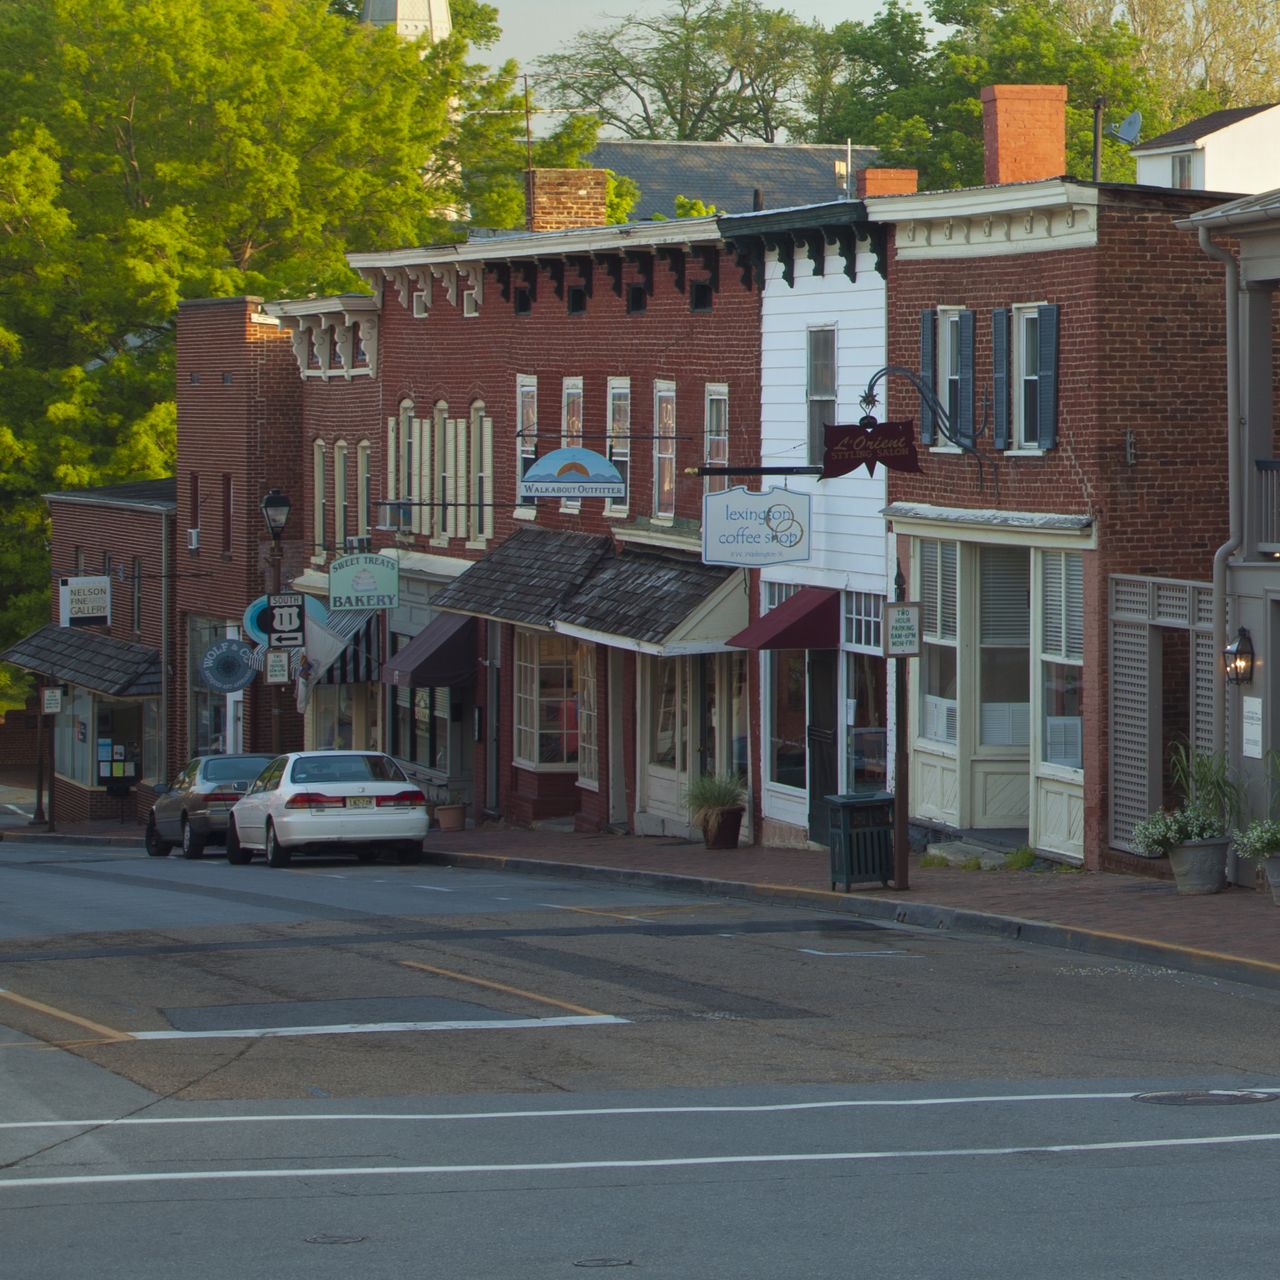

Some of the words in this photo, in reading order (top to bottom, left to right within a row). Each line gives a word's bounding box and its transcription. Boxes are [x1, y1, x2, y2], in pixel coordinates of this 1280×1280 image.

[833, 435, 906, 450] L'Orient
[831, 450, 873, 460] STYLING
[876, 448, 909, 458] SALON
[524, 483, 576, 494] WALKABOUT
[577, 485, 623, 494] OUTFITTER
[725, 504, 791, 526] lexington
[718, 526, 761, 545] coffee
[764, 532, 798, 546] shop
[332, 557, 360, 573] SWEET
[363, 556, 396, 571] TREATS
[70, 587, 107, 596] NELSON
[70, 597, 89, 606] FINE
[272, 596, 300, 605] SOUTH
[332, 594, 396, 608] BAKERY
[70, 605, 108, 616] GALLERY
[896, 609, 910, 617] TWO
[279, 612, 293, 626] 11
[203, 642, 230, 668] WOLF
